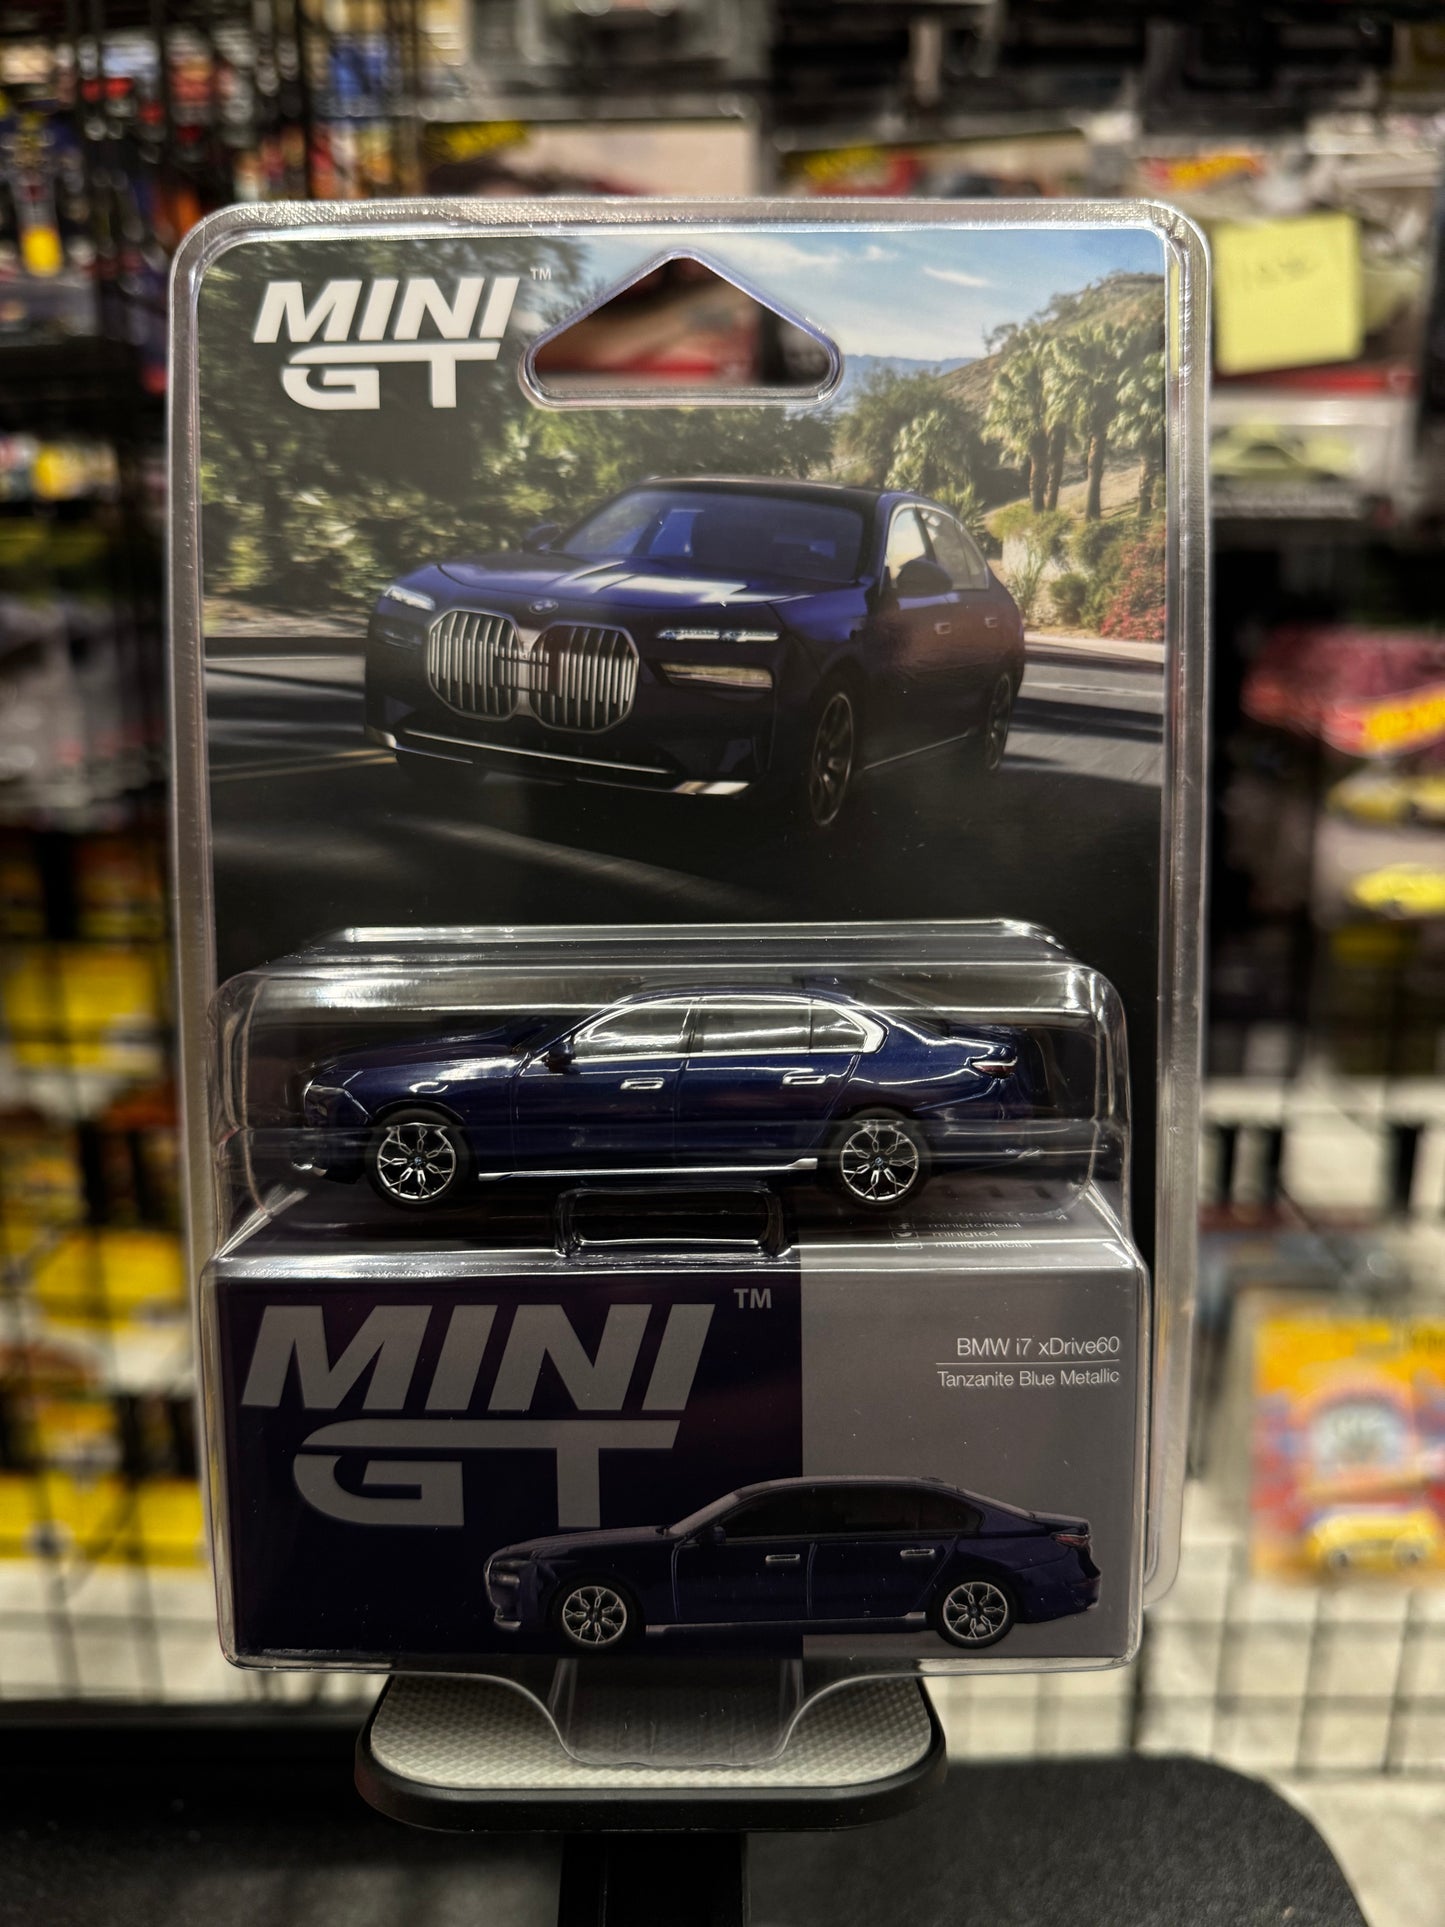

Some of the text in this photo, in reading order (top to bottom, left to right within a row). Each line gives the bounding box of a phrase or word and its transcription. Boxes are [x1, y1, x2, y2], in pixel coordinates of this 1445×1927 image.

[253, 276, 520, 343] MINI
[281, 342, 500, 410] GT
[241, 1287, 773, 1411] MINI TM
[937, 1368, 1121, 1387] Tanzanite Blue Metallic
[957, 1336, 1121, 1356] BMW i7 xDrive60
[293, 1418, 681, 1528] GT
